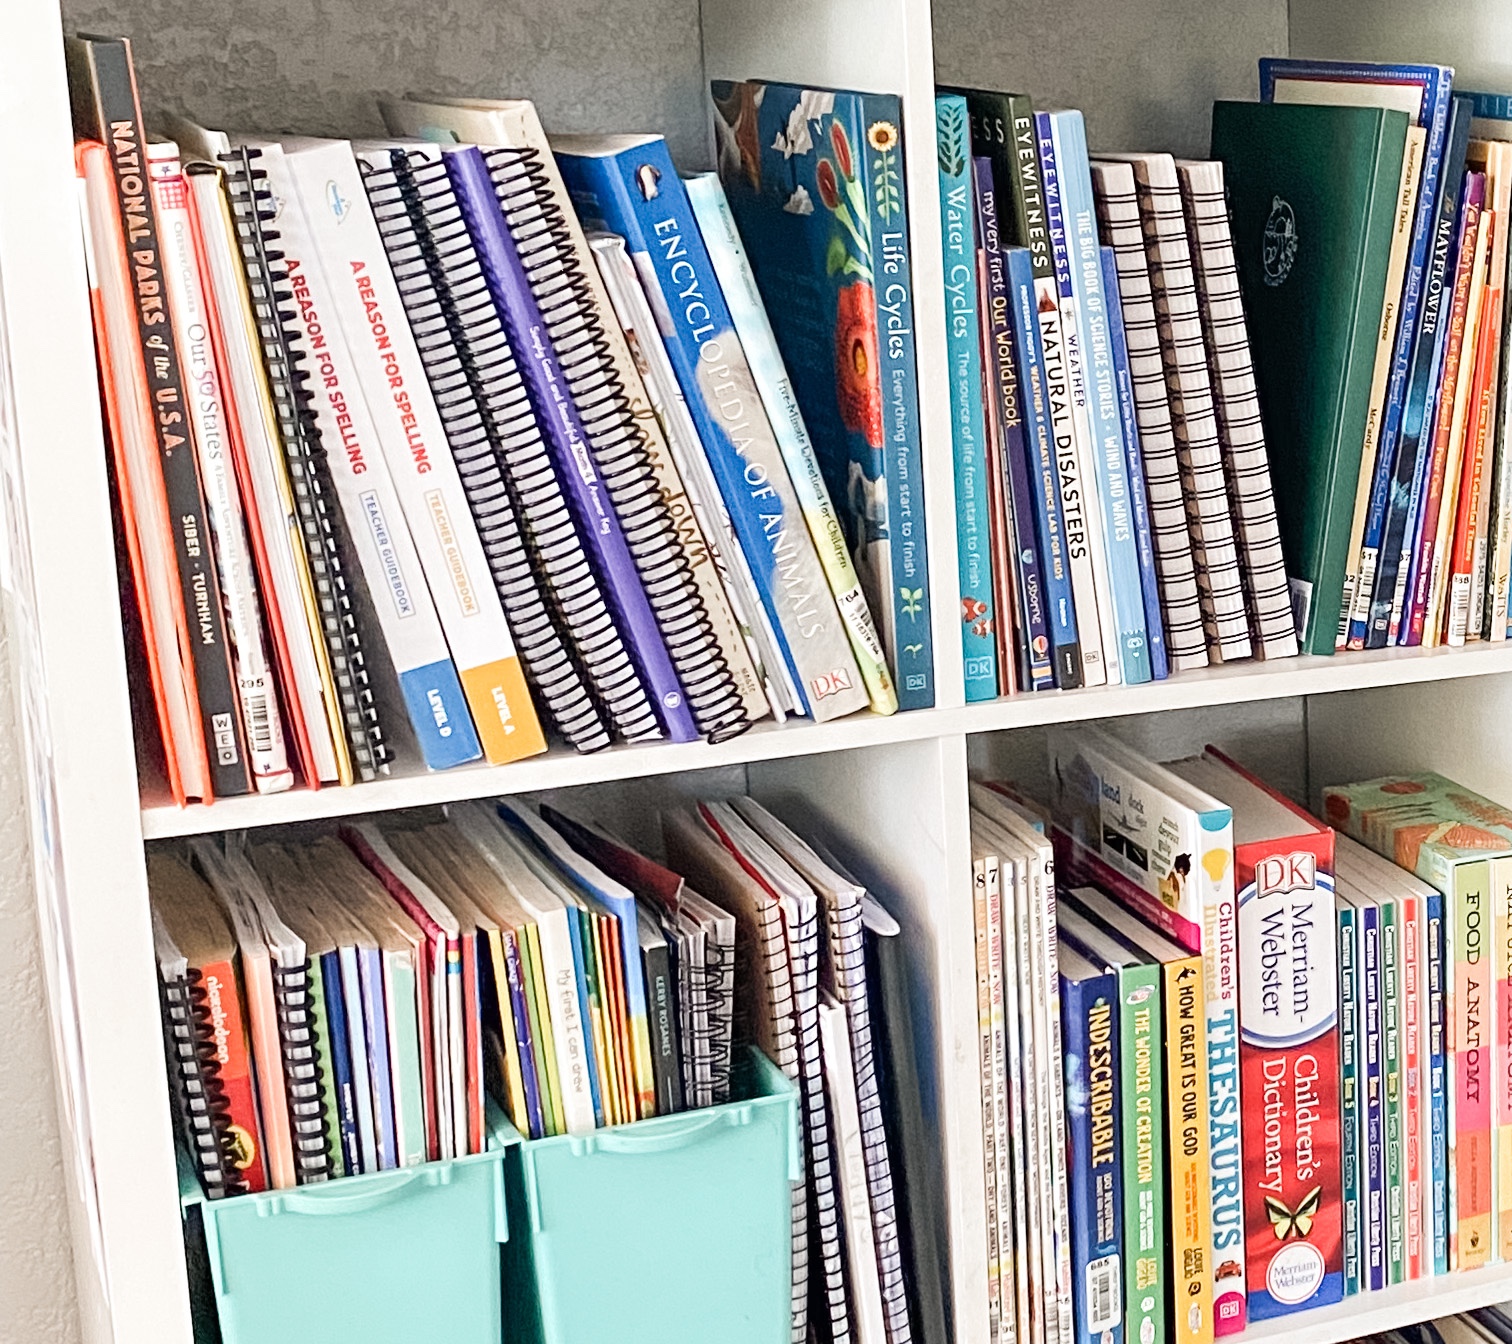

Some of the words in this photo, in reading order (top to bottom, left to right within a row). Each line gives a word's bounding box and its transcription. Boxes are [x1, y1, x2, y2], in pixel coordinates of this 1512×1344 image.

[109, 121, 151, 244] NATIONAL
[881, 232, 908, 274] Life
[947, 185, 968, 255] Water
[1076, 210, 1092, 235] THE
[1079, 237, 1096, 259] BIG
[132, 251, 165, 325] PARKS
[284, 259, 301, 273] A
[945, 264, 974, 338] Cycles
[1082, 262, 1100, 295] BOOK
[1422, 218, 1452, 334] MAYFLOWER
[289, 274, 328, 350] REASON
[653, 217, 752, 455] ENCYCLOPEDIA
[879, 284, 911, 360] Cycles
[1014, 117, 1048, 269] EYEWITNESS
[1040, 320, 1070, 427] NATURAL
[1056, 436, 1087, 560] DISASTERS
[1087, 298, 1102, 313] OF
[146, 335, 168, 351] of
[153, 356, 172, 379] the
[316, 355, 338, 389] FOR
[1090, 316, 1111, 367] SCIENCE
[155, 386, 187, 456] U.S.A.
[1099, 369, 1116, 420] STORIES
[328, 390, 368, 475] SPELLING
[1103, 436, 1120, 470] WIND
[743, 462, 775, 502] OF
[1109, 473, 1125, 498] AND
[362, 494, 390, 546] TEACHER
[381, 548, 411, 614] GUIDEBOOK
[1112, 501, 1130, 542] WAVES
[758, 512, 825, 639] ANIMALS
[1260, 909, 1286, 1016] Webster
[1291, 904, 1313, 1023] Merriam-
[1466, 892, 1481, 966] FOOD
[205, 976, 233, 1064] nickelodeon
[1179, 985, 1195, 1020] HOW
[1179, 1024, 1197, 1069] GREAT
[1466, 977, 1480, 1104] ANATOMY
[1088, 1007, 1114, 1168] INDESCRIBABLE
[1182, 1074, 1197, 1089] IS
[1182, 1093, 1198, 1123] OUR
[1183, 1127, 1200, 1157] GOD
[1207, 1009, 1241, 1250] THESAURUS
[1259, 1058, 1287, 1193] Dictionary
[1293, 1055, 1321, 1181] Children's
